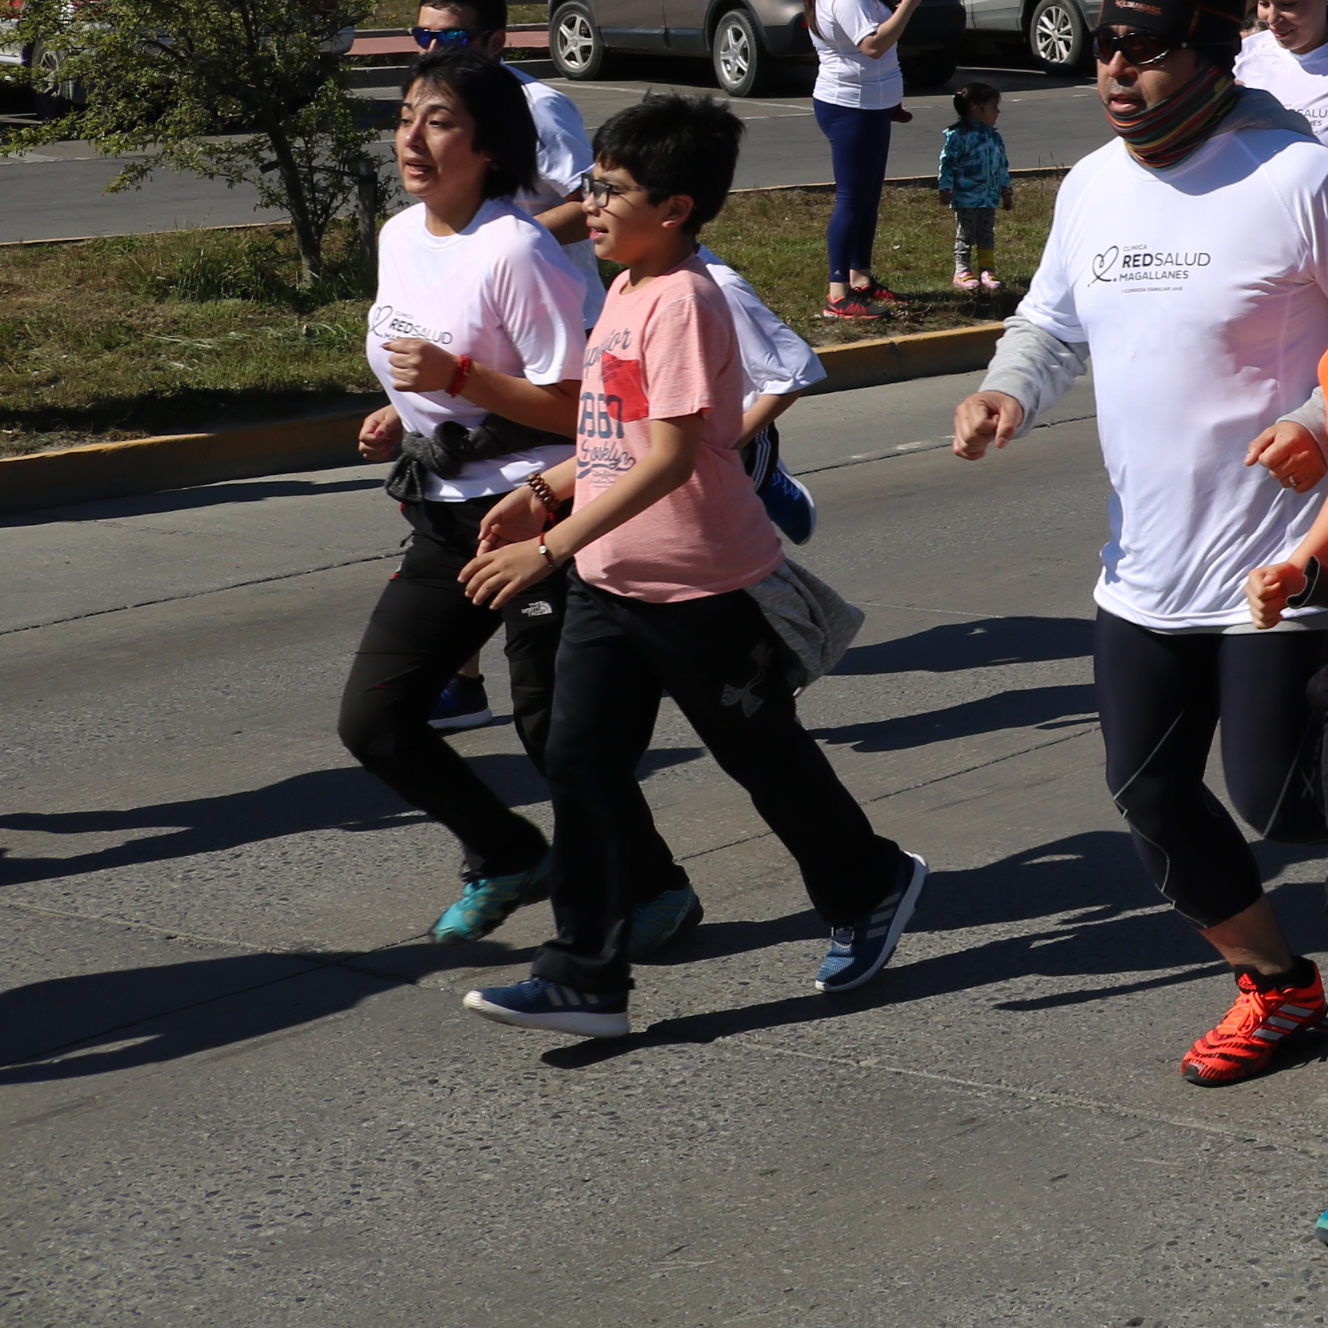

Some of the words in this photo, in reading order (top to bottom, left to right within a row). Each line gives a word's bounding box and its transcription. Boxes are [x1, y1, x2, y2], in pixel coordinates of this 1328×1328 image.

[1123, 244, 1148, 252] CLINICA
[1122, 252, 1211, 268] REDSALUD
[1119, 270, 1189, 281] MAGALLANES
[389, 318, 453, 345] REDSALUD
